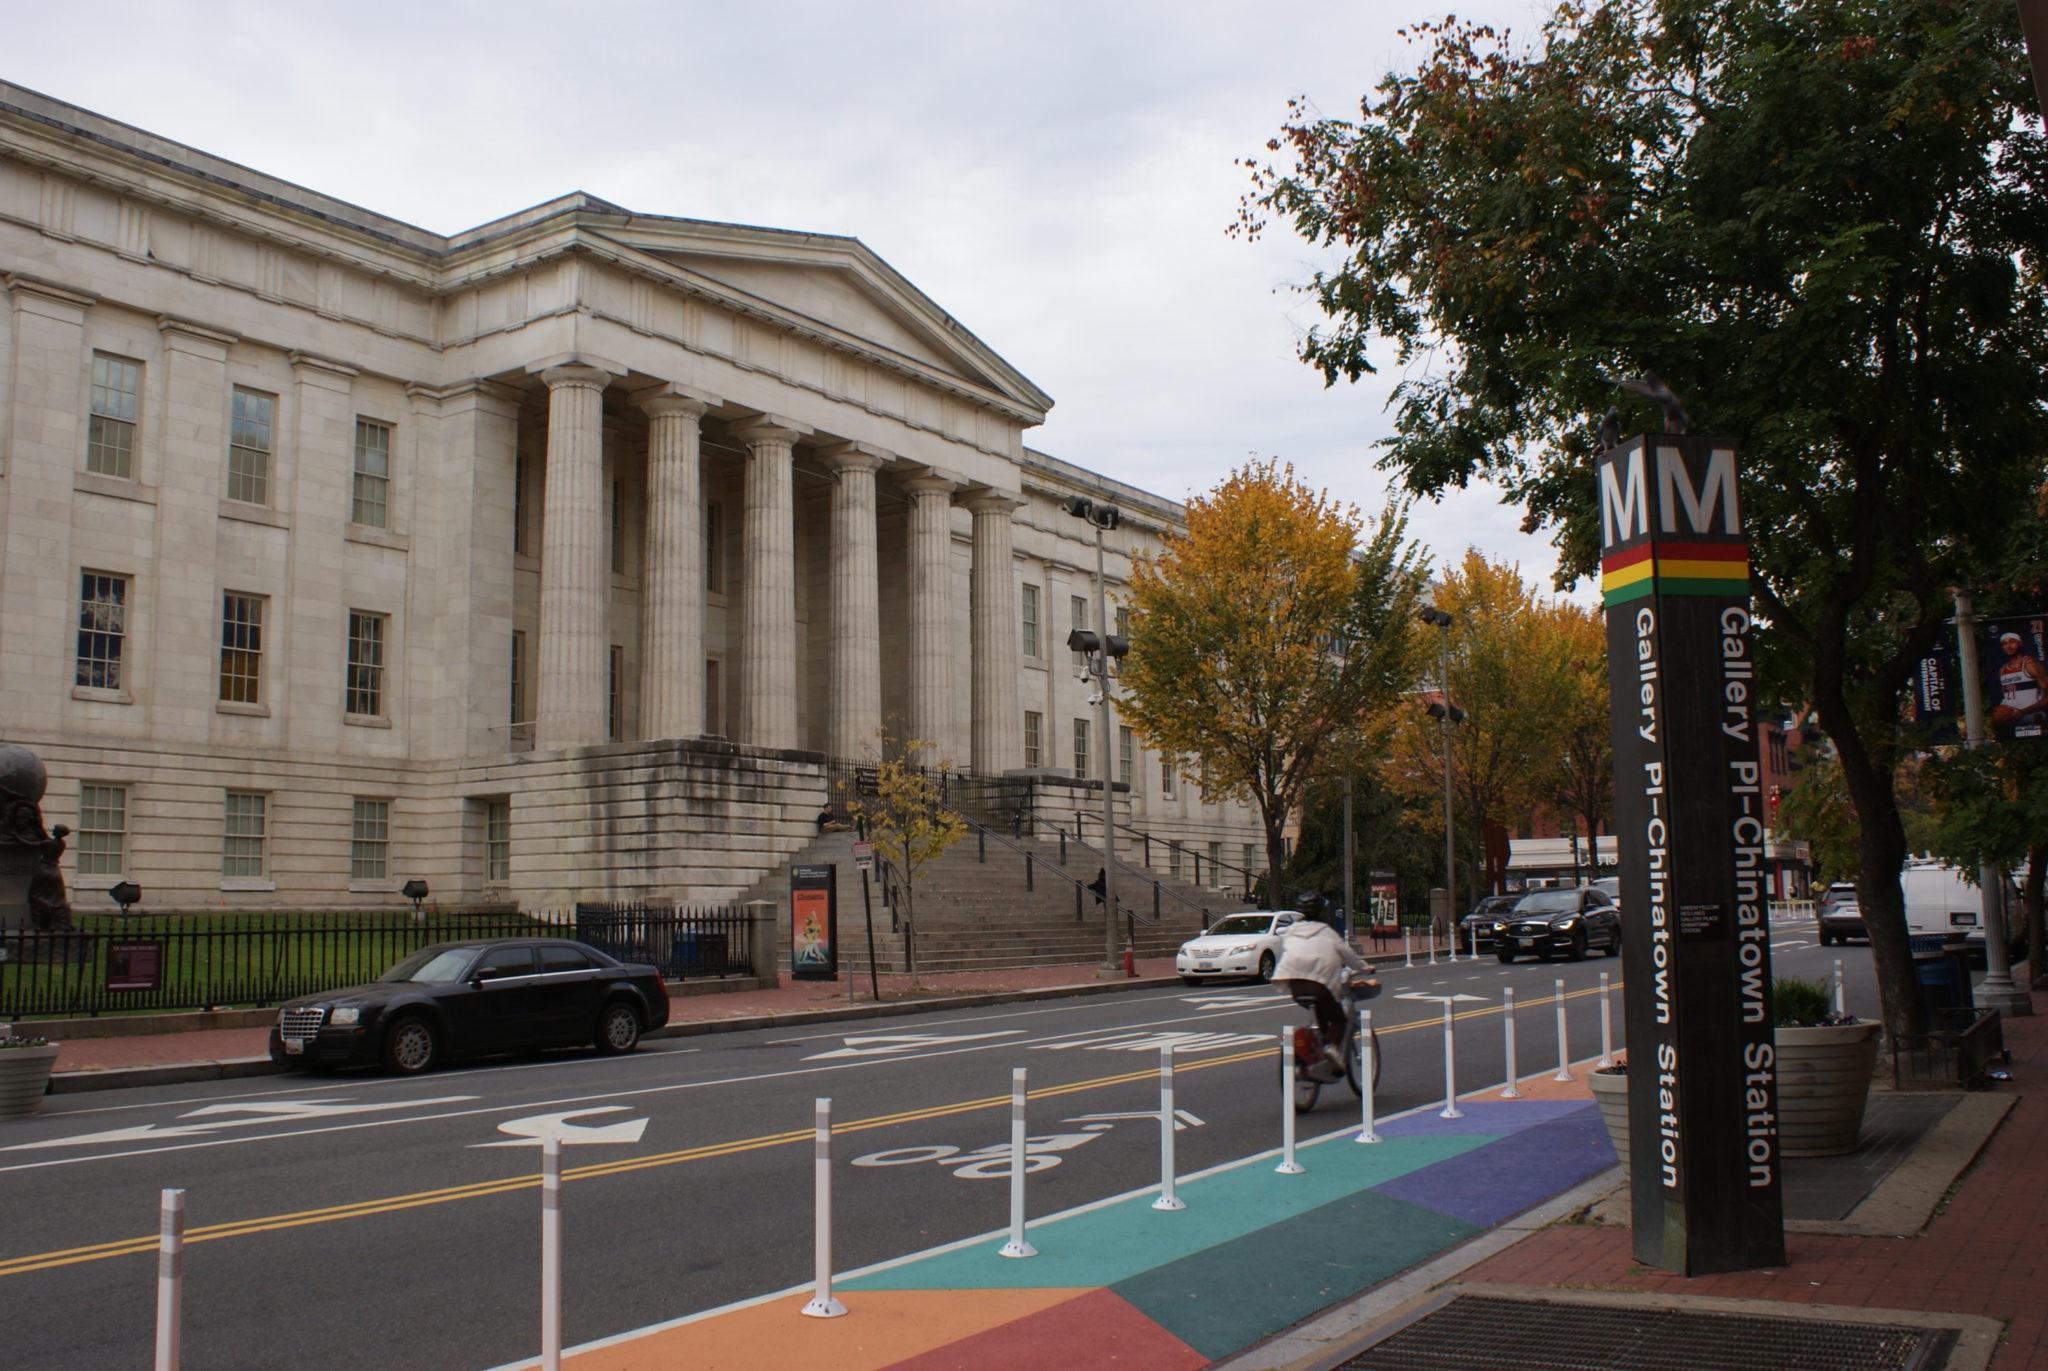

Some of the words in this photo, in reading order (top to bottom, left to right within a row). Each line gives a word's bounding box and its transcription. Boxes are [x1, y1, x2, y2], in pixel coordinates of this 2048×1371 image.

[1600, 447, 1648, 548] M
[1655, 446, 1740, 535] M
[1636, 607, 1657, 743] Gallery
[1720, 606, 1753, 743] Gallery
[1927, 657, 1939, 695] CAPITAL
[1931, 699, 1941, 711] OF
[1644, 761, 1671, 1024] Pl-Chinatown
[1730, 761, 1766, 1023] Pl-Chinatown
[1657, 1043, 1679, 1188] Station
[1743, 1042, 1777, 1188] Station
